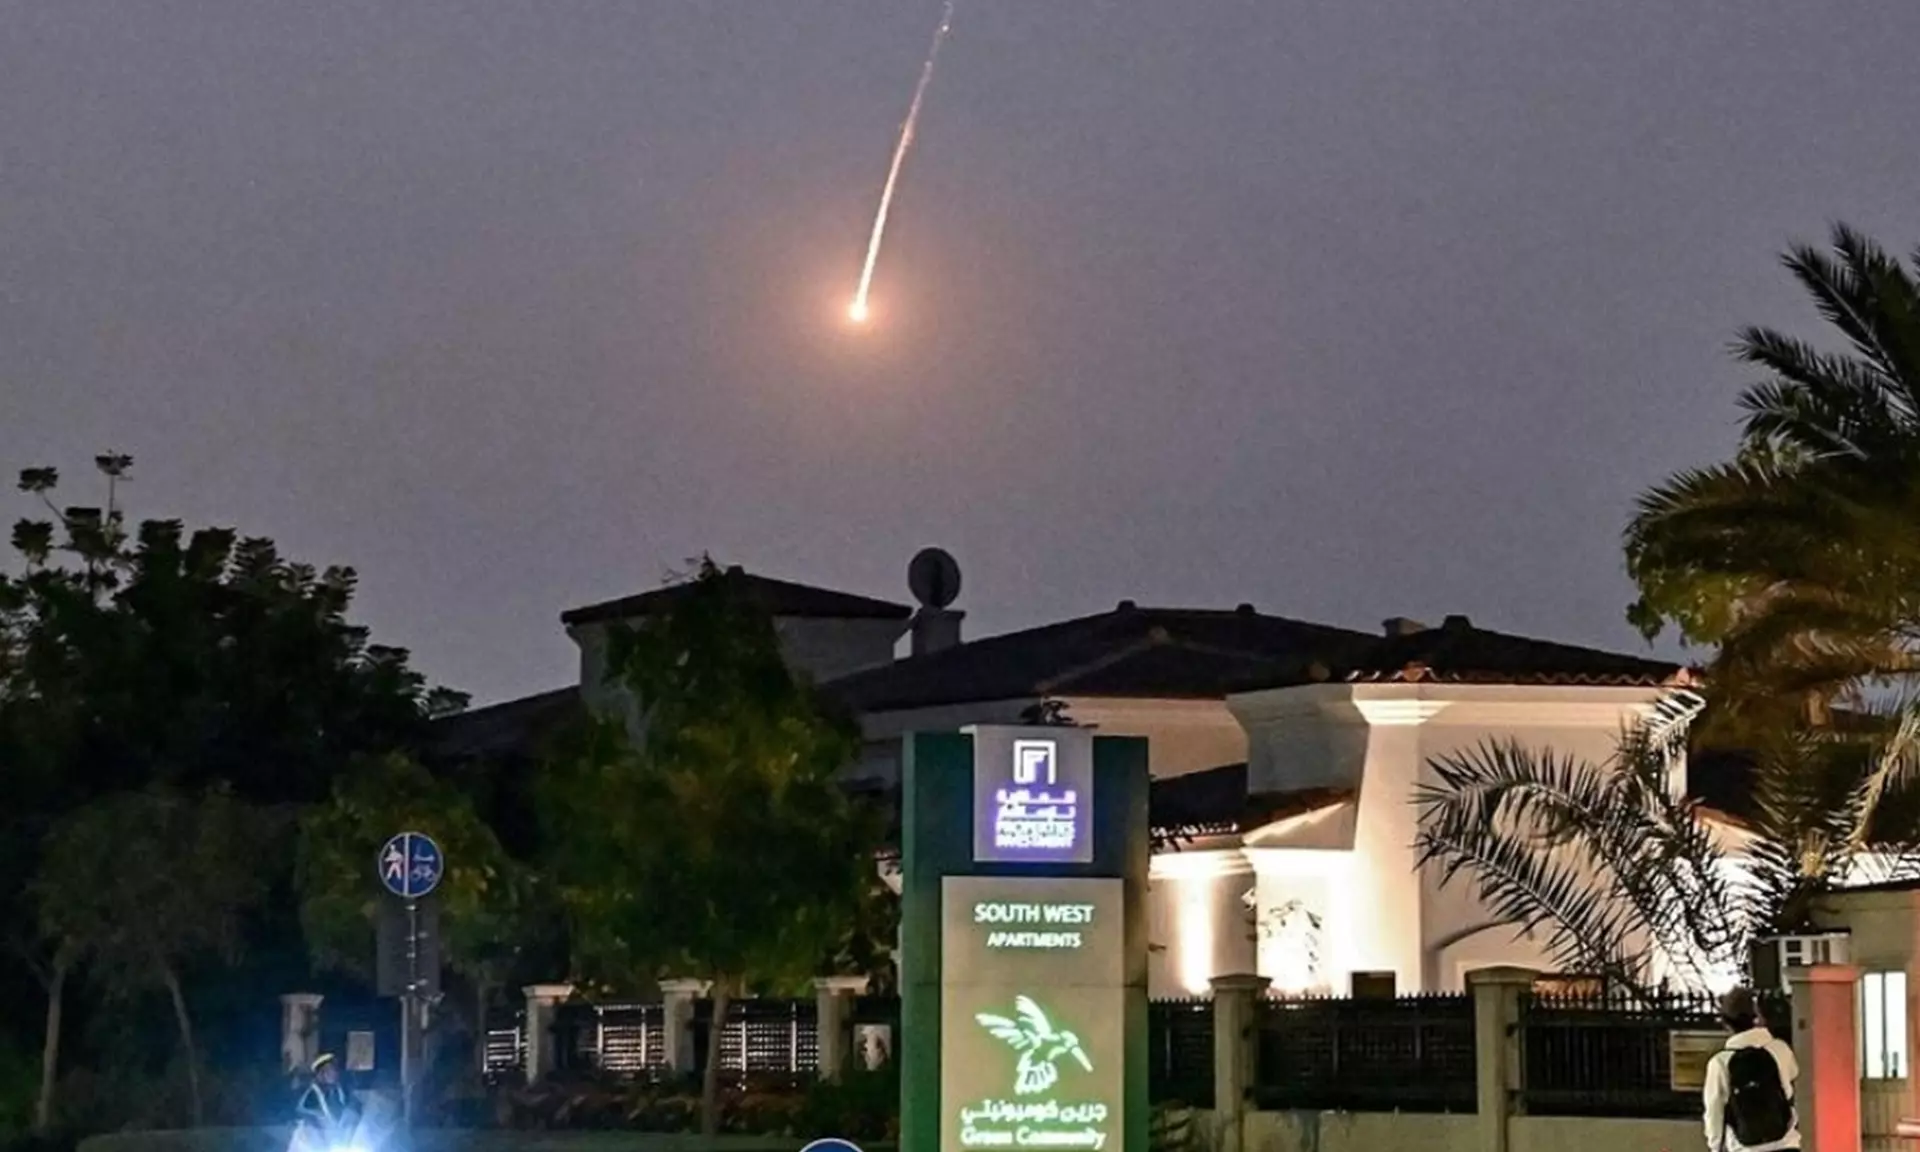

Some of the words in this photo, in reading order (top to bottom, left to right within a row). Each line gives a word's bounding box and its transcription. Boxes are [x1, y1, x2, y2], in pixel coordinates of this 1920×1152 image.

[974, 903, 1040, 922] SOUTH
[1042, 903, 1095, 922] WEST
[986, 932, 1081, 948] APARTMENTS
